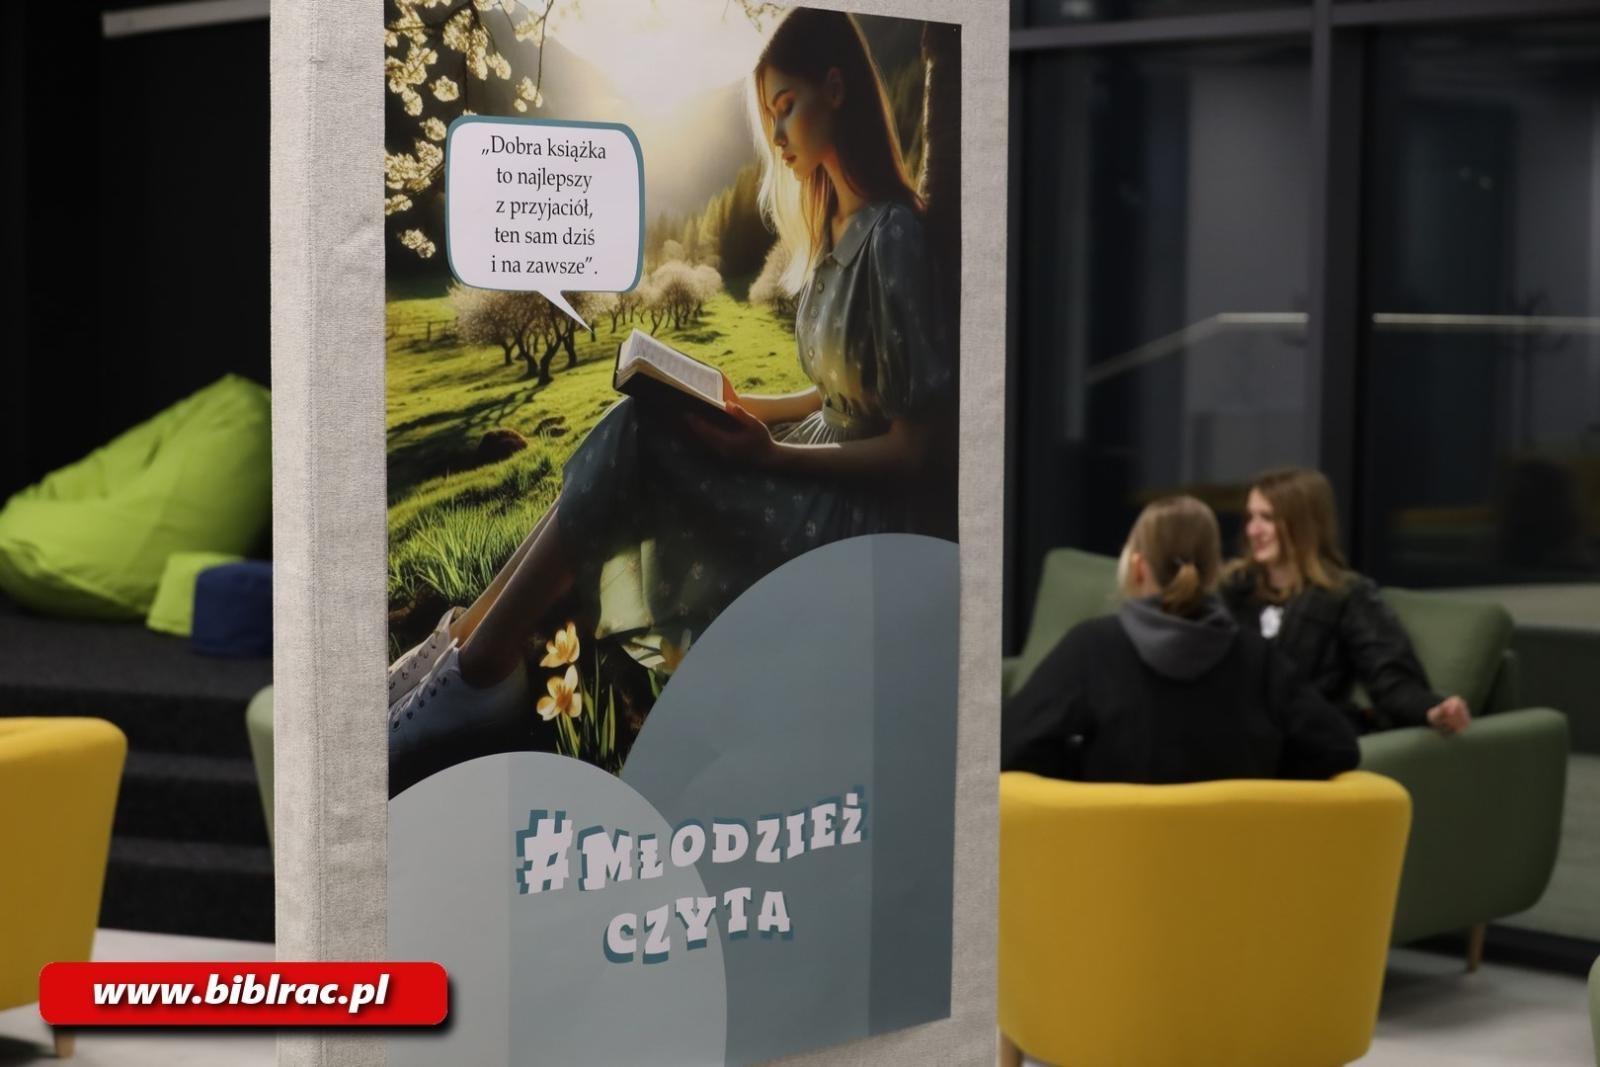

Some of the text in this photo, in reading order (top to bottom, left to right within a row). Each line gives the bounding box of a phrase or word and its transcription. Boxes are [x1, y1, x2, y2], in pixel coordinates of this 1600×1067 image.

[481, 135, 607, 162] „Dobra książka
[496, 167, 592, 194] to najlepszy
[495, 198, 593, 221] z przyjaciół,
[494, 227, 596, 246] ten sam dziś
[491, 254, 497, 273] i
[501, 259, 521, 274] na
[516, 786, 867, 895] #MŁODZIEŻ
[603, 886, 794, 962] CZYTA
